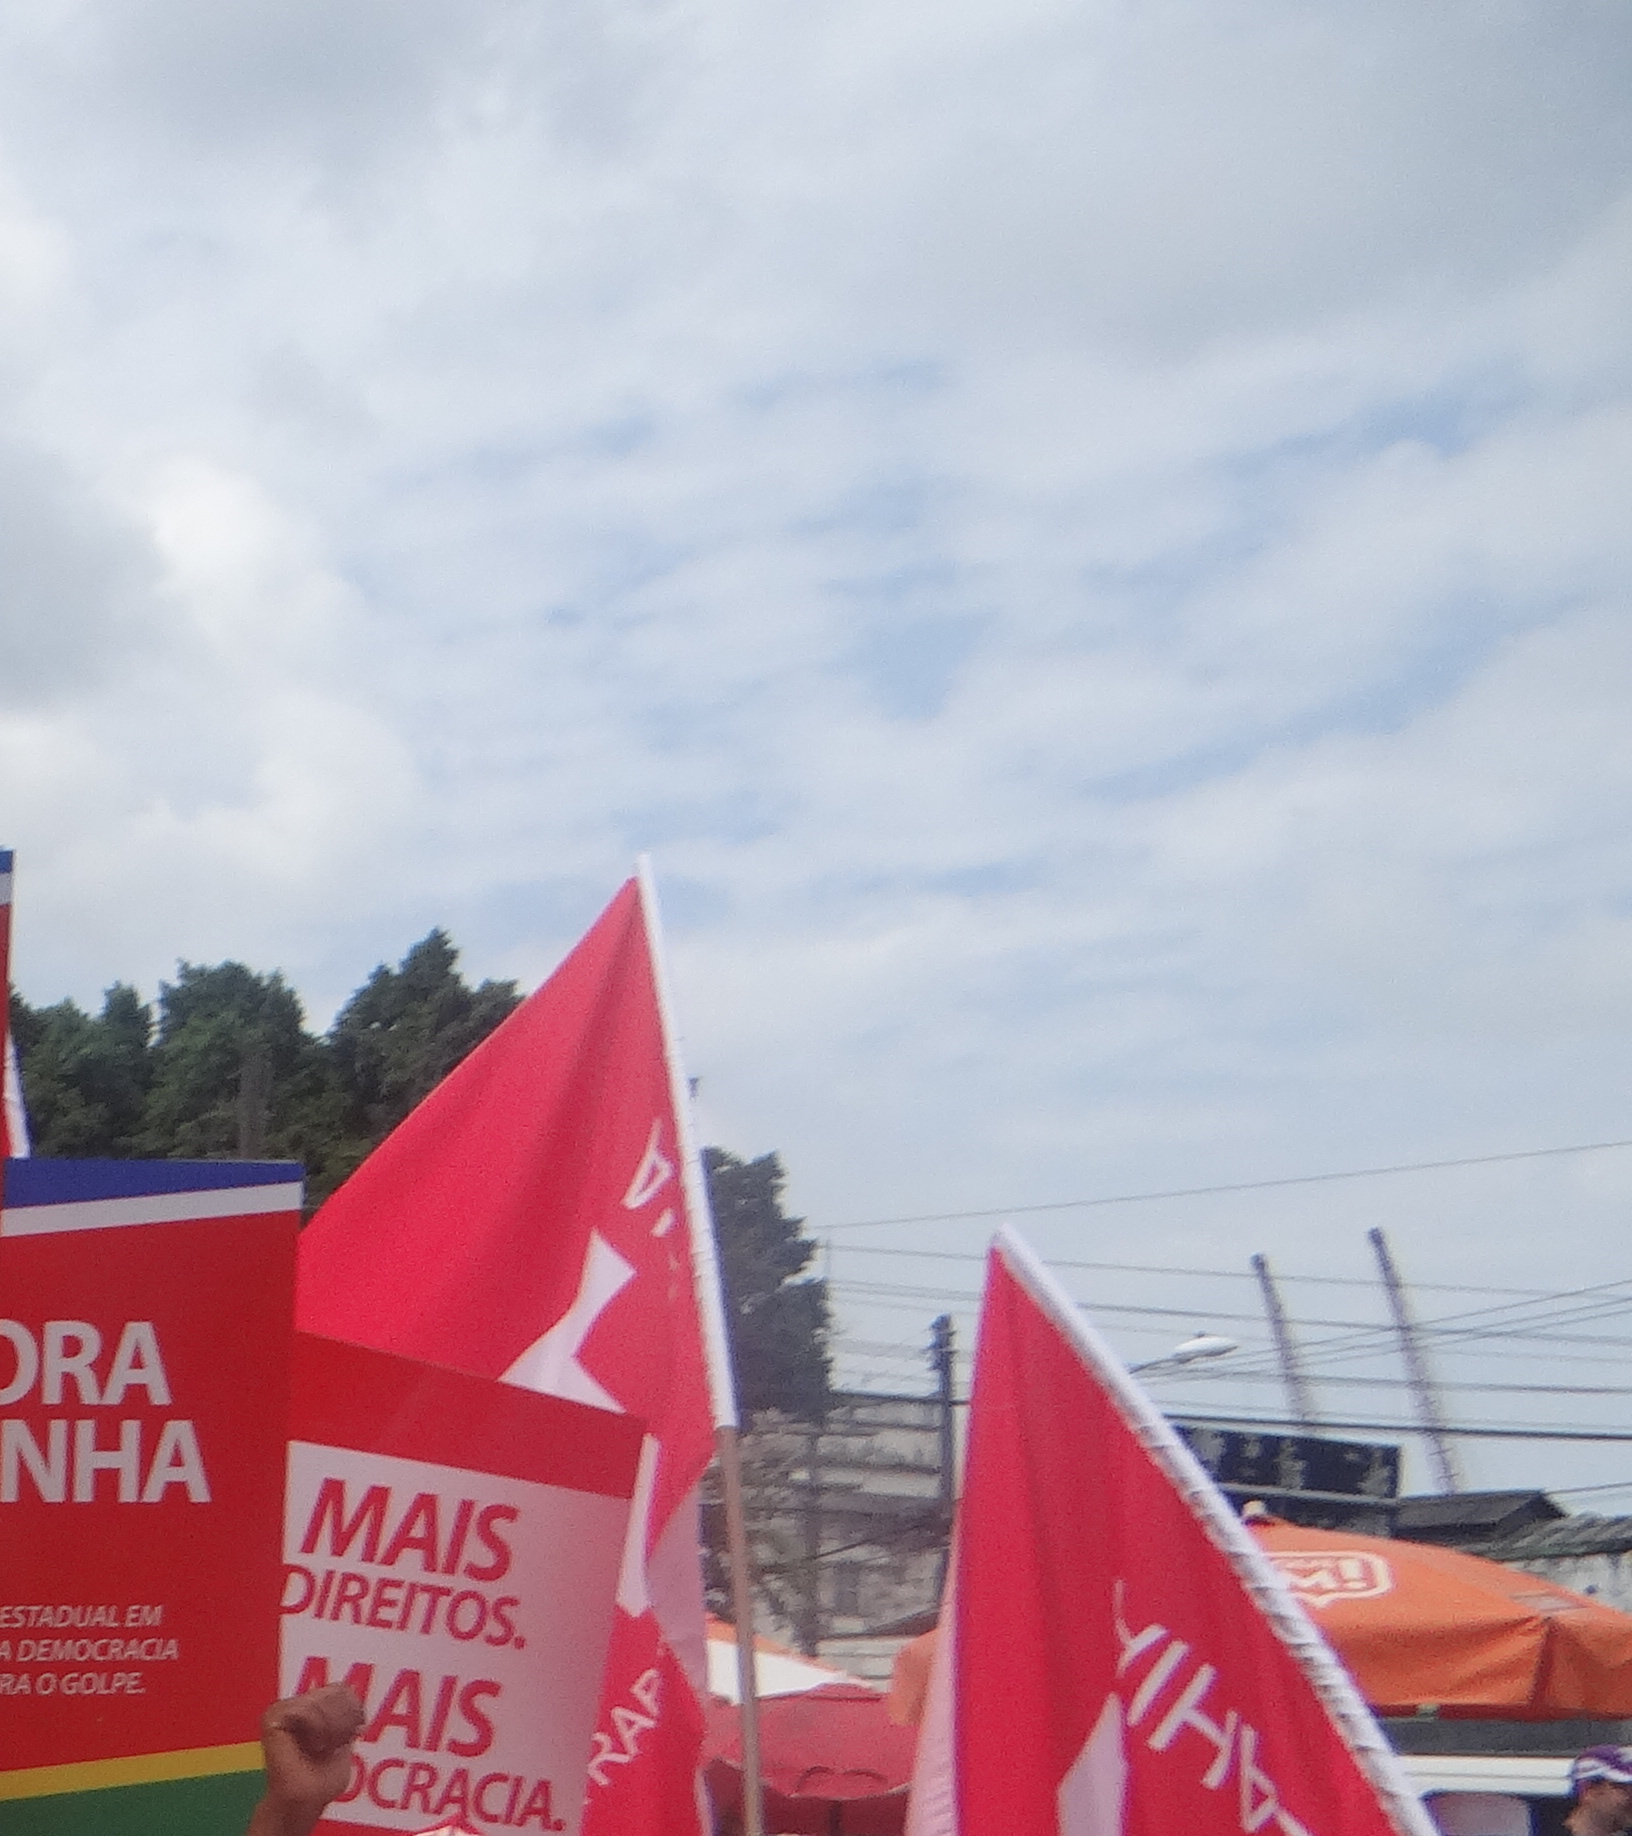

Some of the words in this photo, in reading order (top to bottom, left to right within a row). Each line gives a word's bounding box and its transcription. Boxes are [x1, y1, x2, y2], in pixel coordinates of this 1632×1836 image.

[0, 1420, 211, 1503] NHA
[300, 1477, 521, 1582] MAIS
[124, 1605, 164, 1627] EM
[279, 1563, 526, 1650] DIREITOS.
[16, 1638, 179, 1662] DEMOCRACIA
[36, 1673, 57, 1695] O
[60, 1671, 147, 1695] GOLPE.
